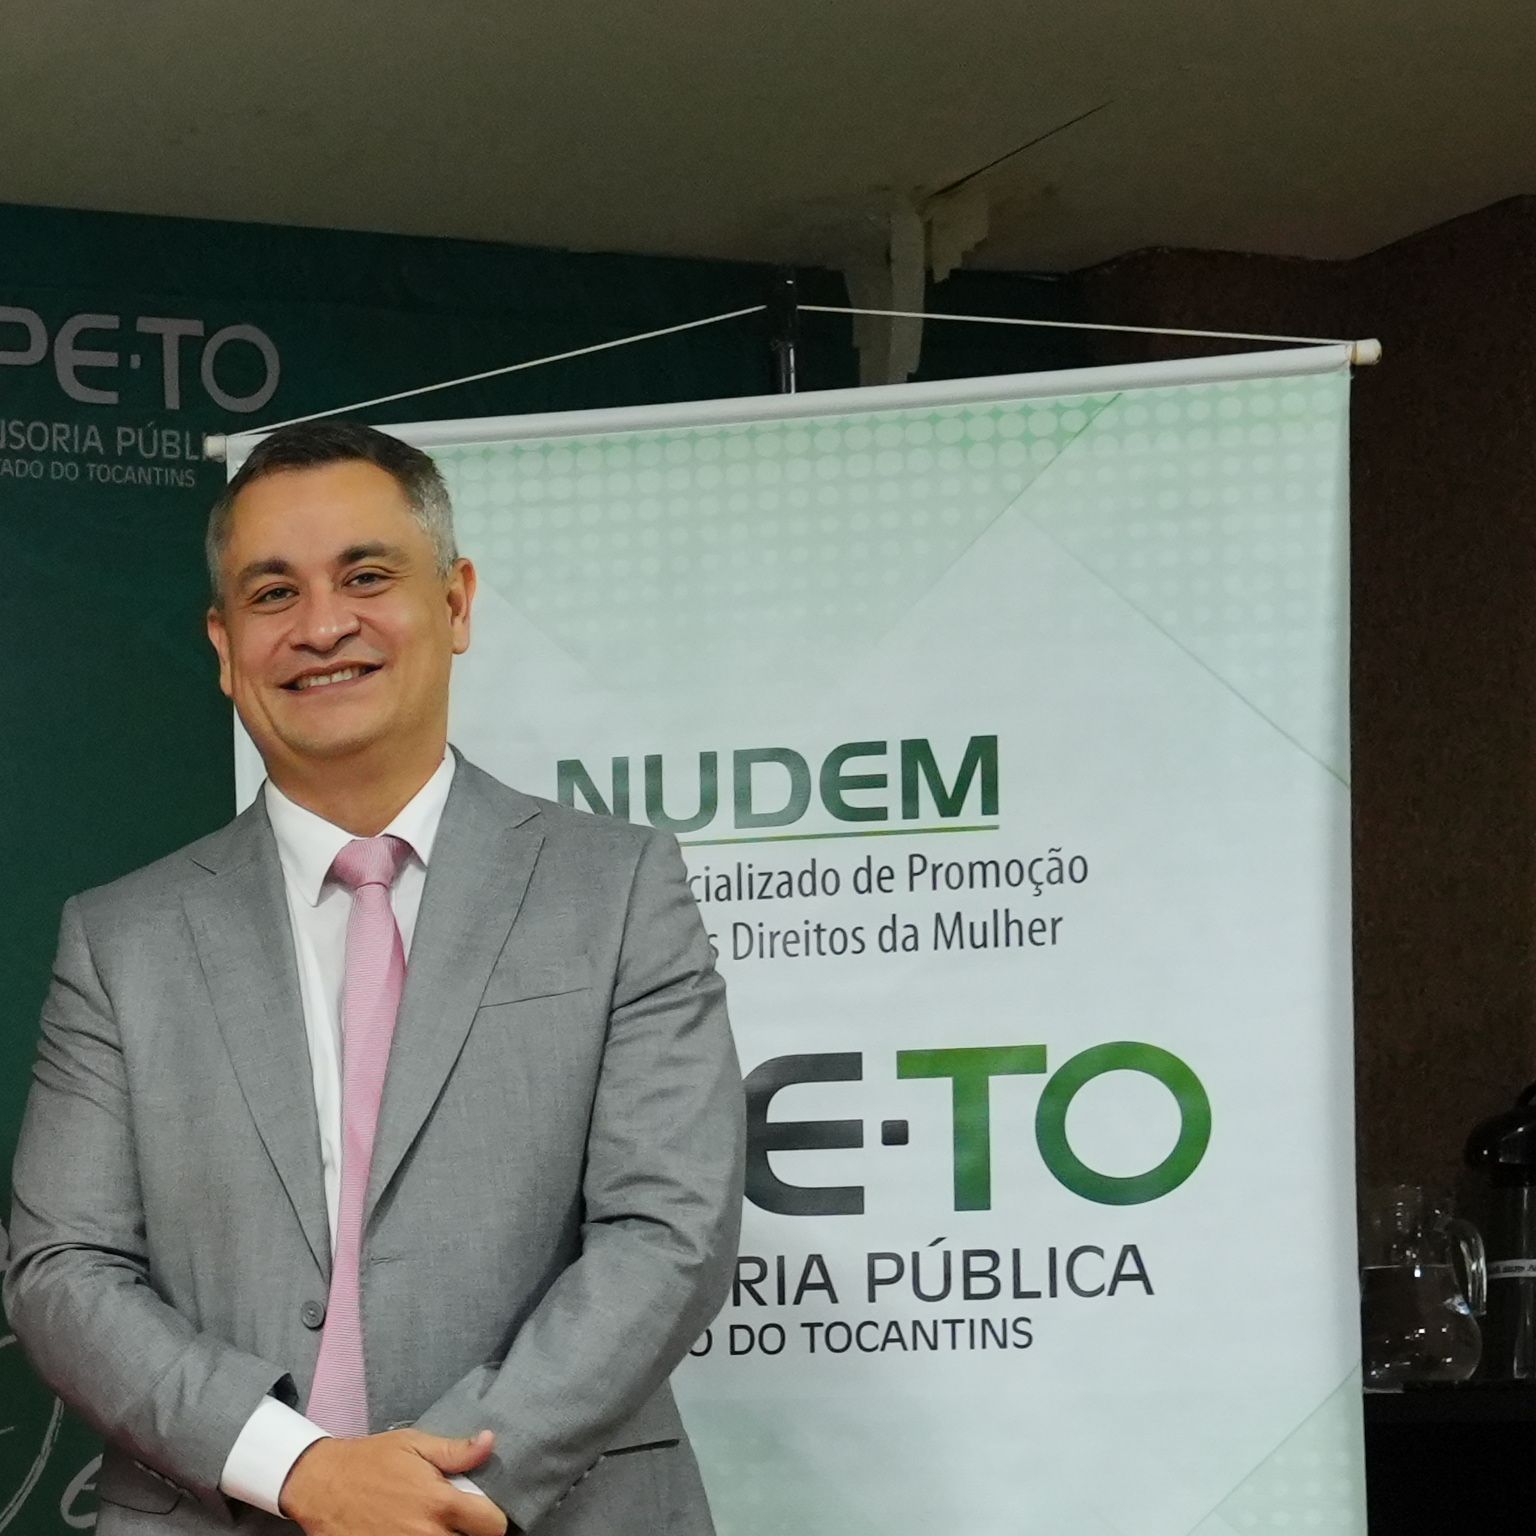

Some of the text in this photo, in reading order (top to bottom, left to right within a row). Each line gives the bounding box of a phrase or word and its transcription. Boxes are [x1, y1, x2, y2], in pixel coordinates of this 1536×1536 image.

[116, 420, 226, 463] PÚBLI
[50, 460, 80, 482] DO
[87, 463, 196, 489] TOCANTINS
[556, 734, 1000, 834] NUDEM
[852, 857, 895, 896] de
[908, 847, 1089, 897] Promoção
[732, 917, 866, 961] Direitos
[877, 913, 920, 954] da
[933, 906, 1064, 952] Mulher
[866, 1237, 1155, 1304] PÚBLICA
[729, 1322, 786, 1355] DO
[800, 1316, 1033, 1353] TOCANTINS
